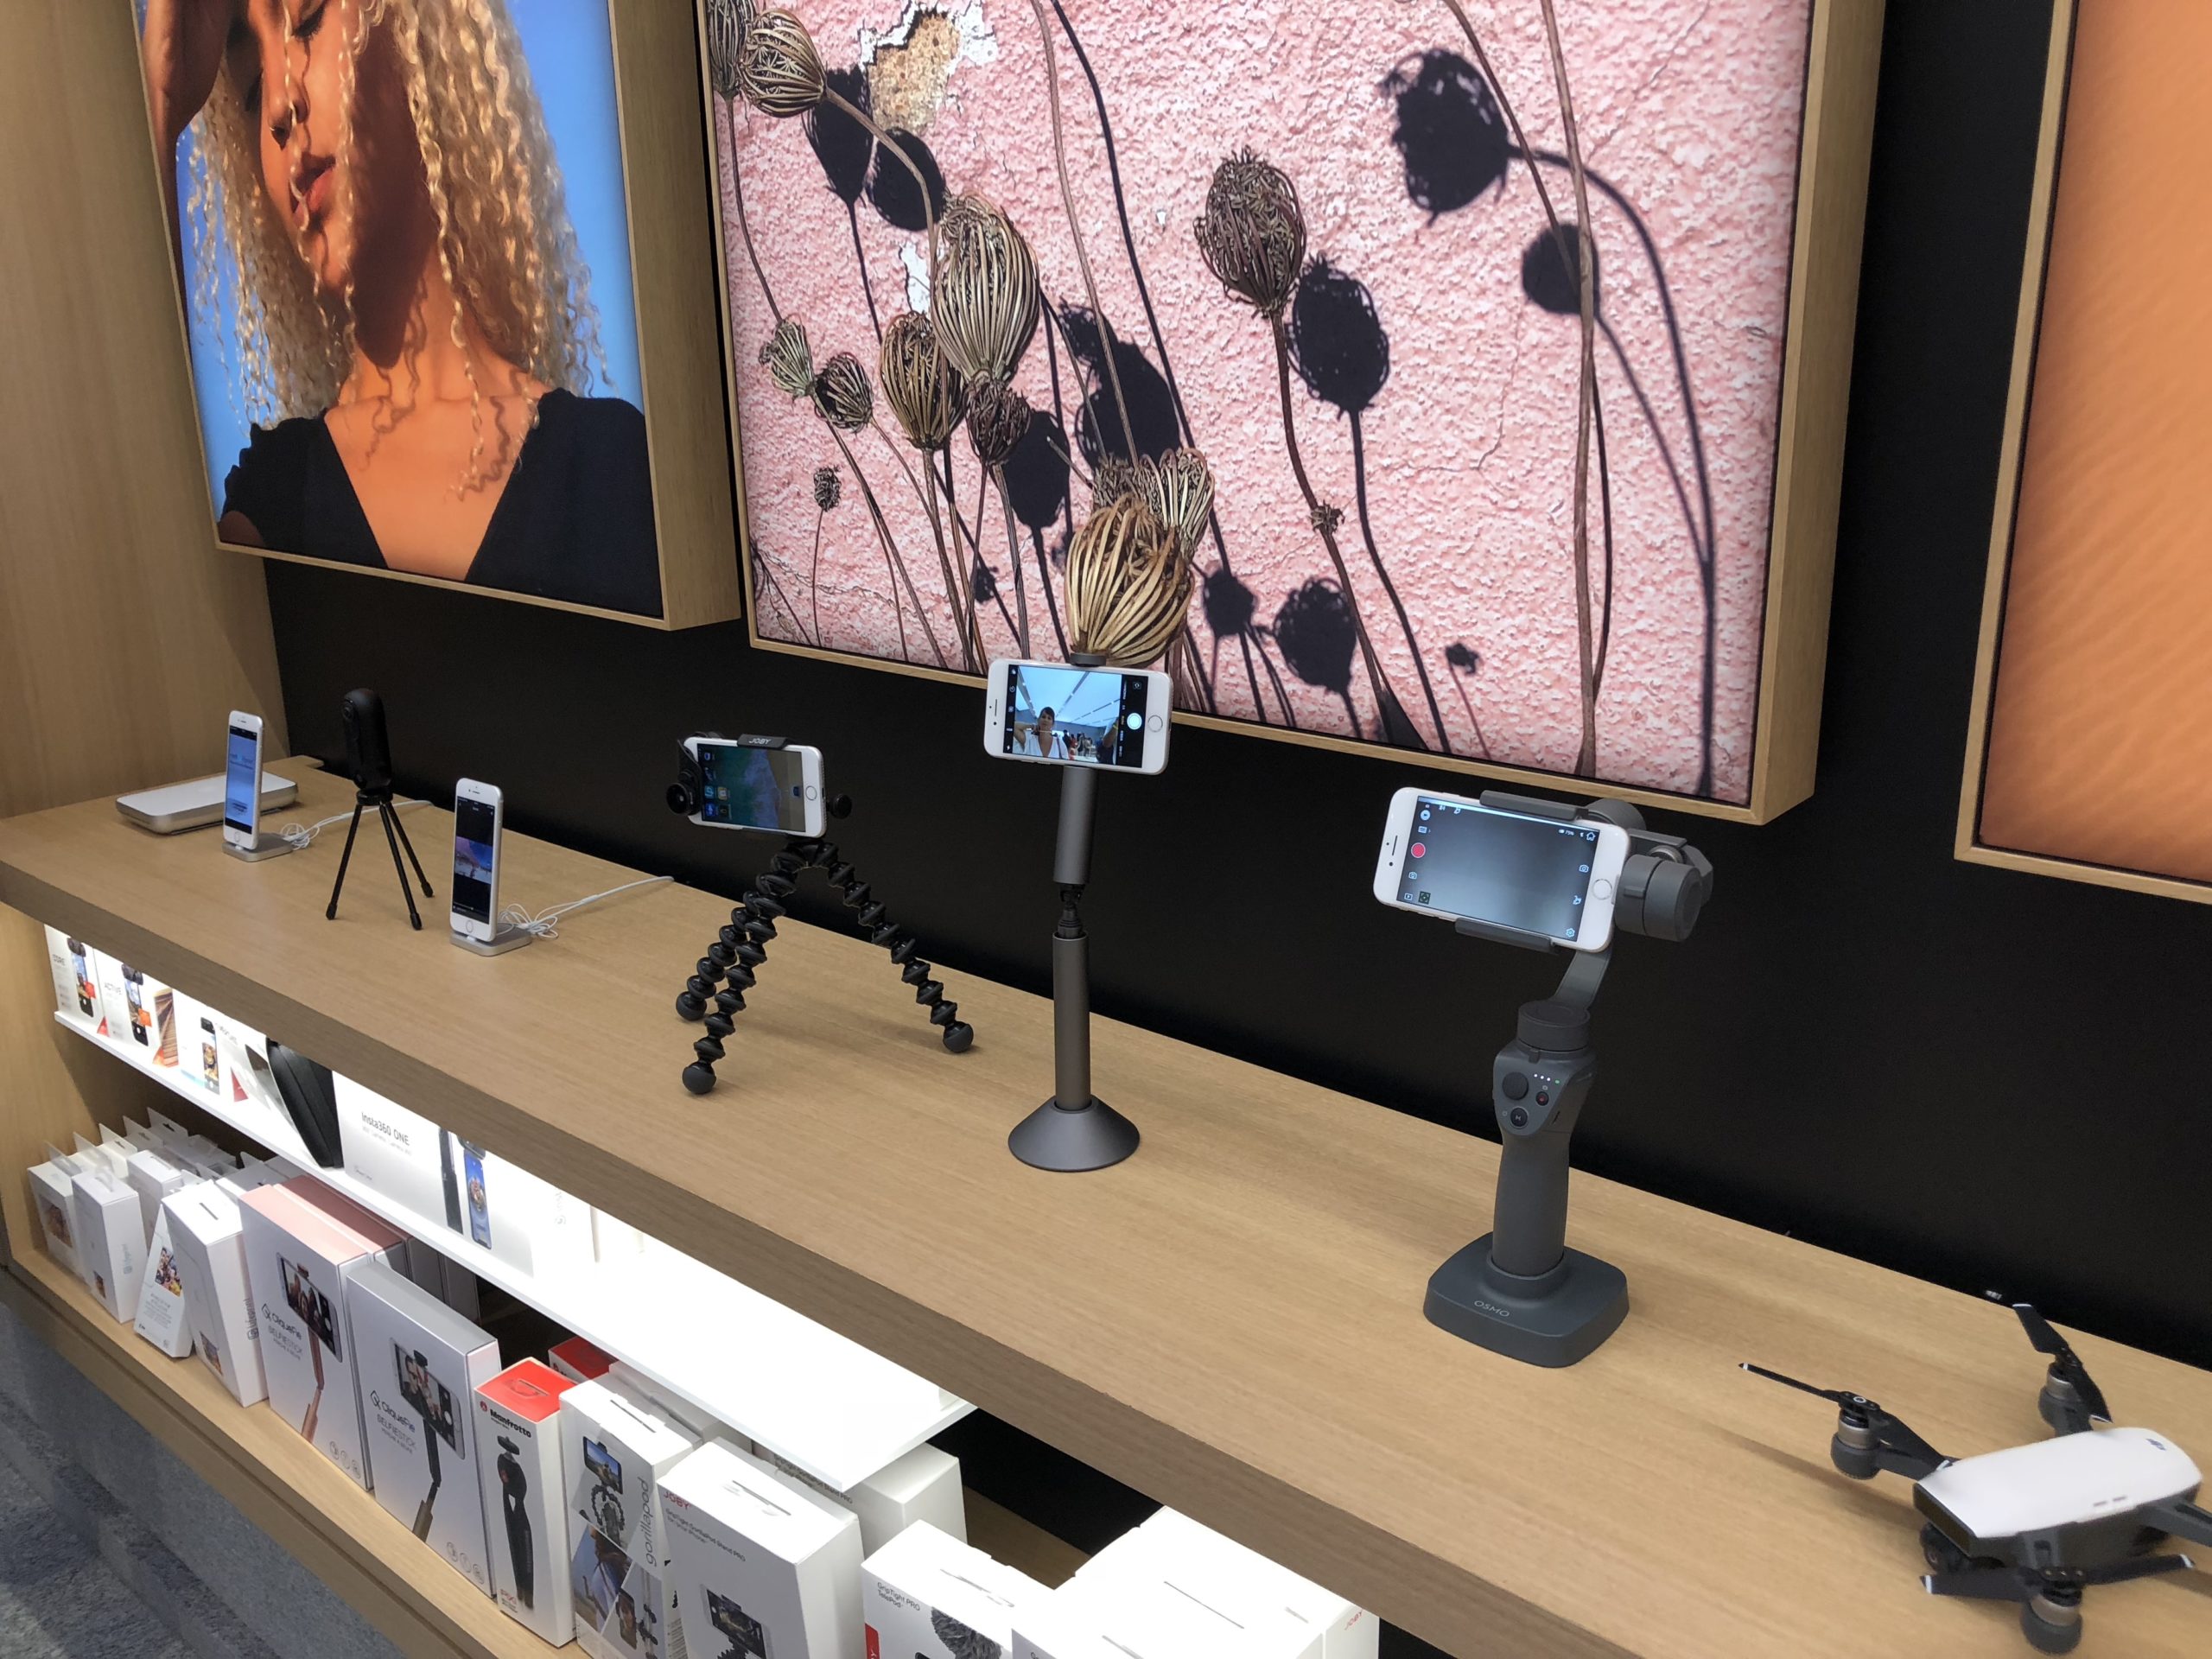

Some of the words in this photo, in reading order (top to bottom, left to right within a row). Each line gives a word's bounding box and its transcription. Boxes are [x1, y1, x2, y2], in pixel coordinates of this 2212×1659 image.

[362, 1111, 391, 1136] Insta360
[393, 1128, 410, 1147] ONE
[1474, 1300, 1510, 1317] OSMO
[490, 1408, 531, 1439] Manfrotto
[664, 1491, 689, 1510] JOBY
[637, 1476, 657, 1567] gorillapod
[877, 1581, 906, 1603] GripTight
[906, 1598, 920, 1611] PRO
